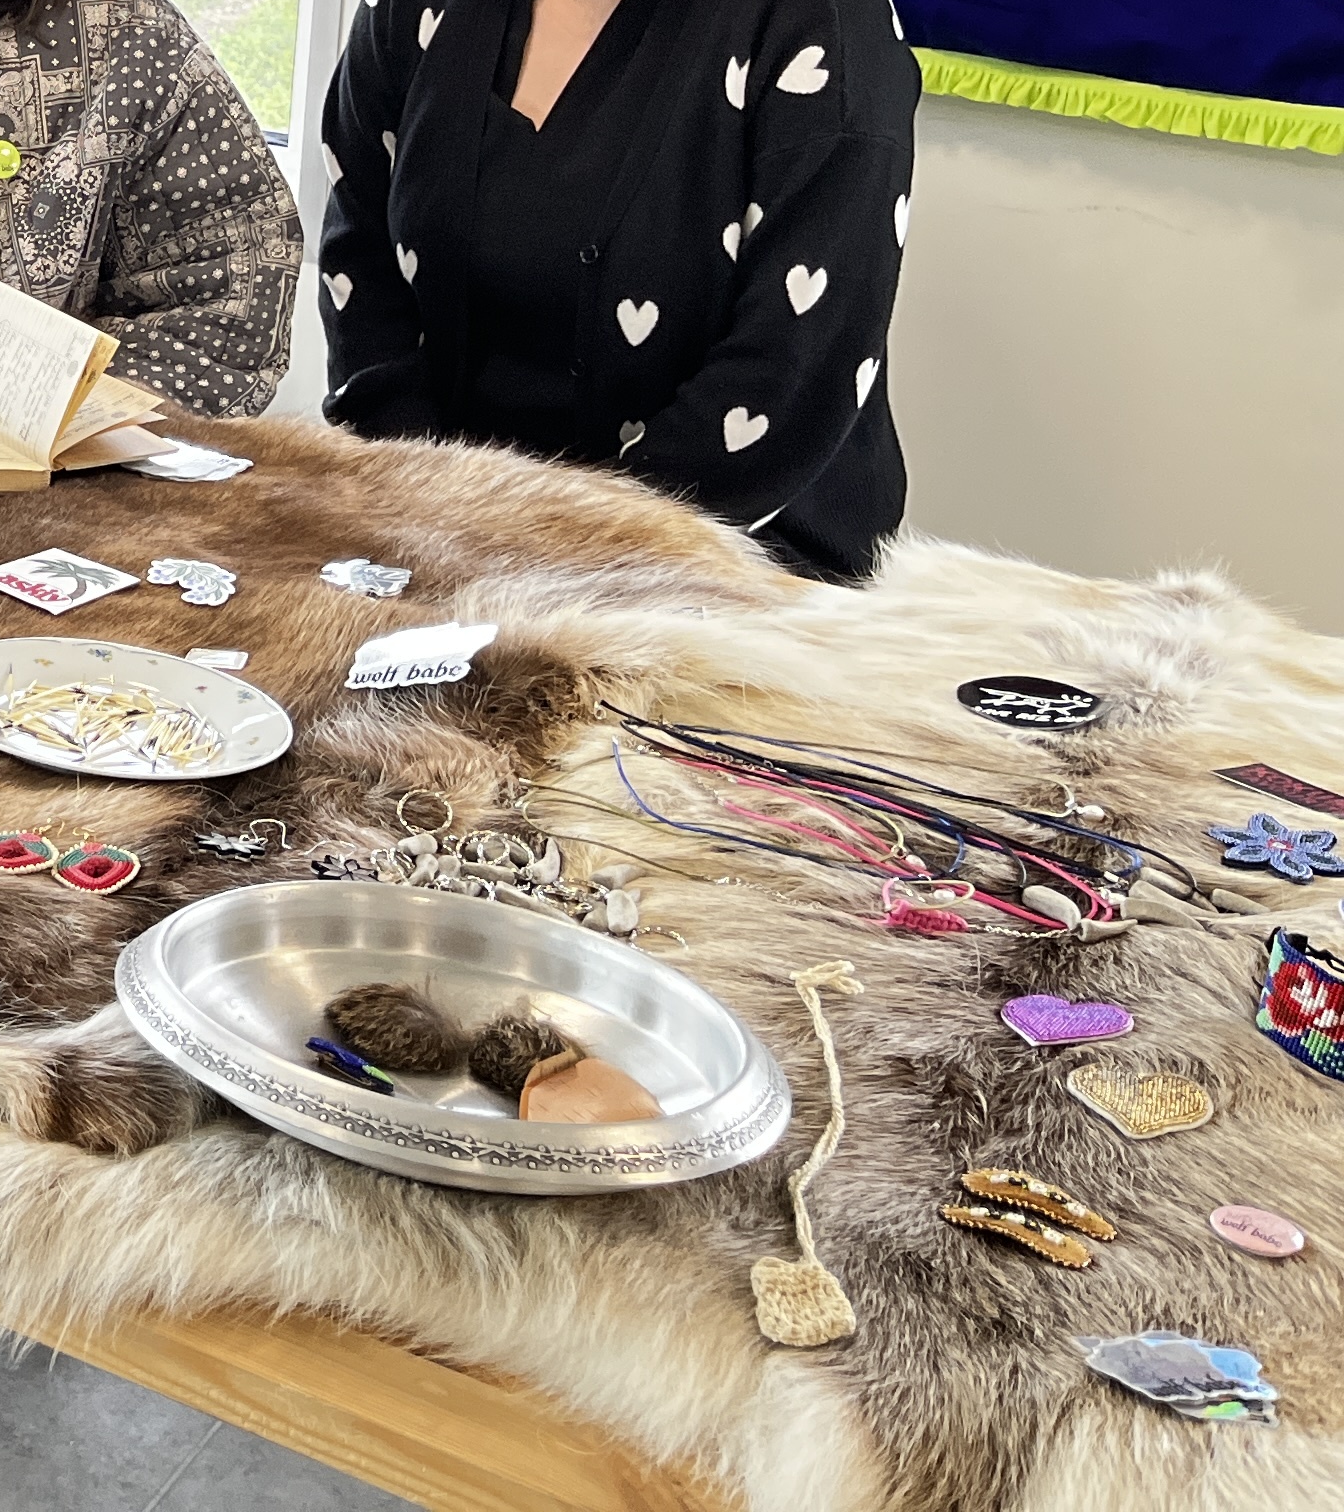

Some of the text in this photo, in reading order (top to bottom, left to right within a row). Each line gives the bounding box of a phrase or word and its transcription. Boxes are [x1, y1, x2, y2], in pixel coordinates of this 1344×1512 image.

[352, 659, 463, 684] wolf babe
[1220, 1216, 1252, 1232] wolf
